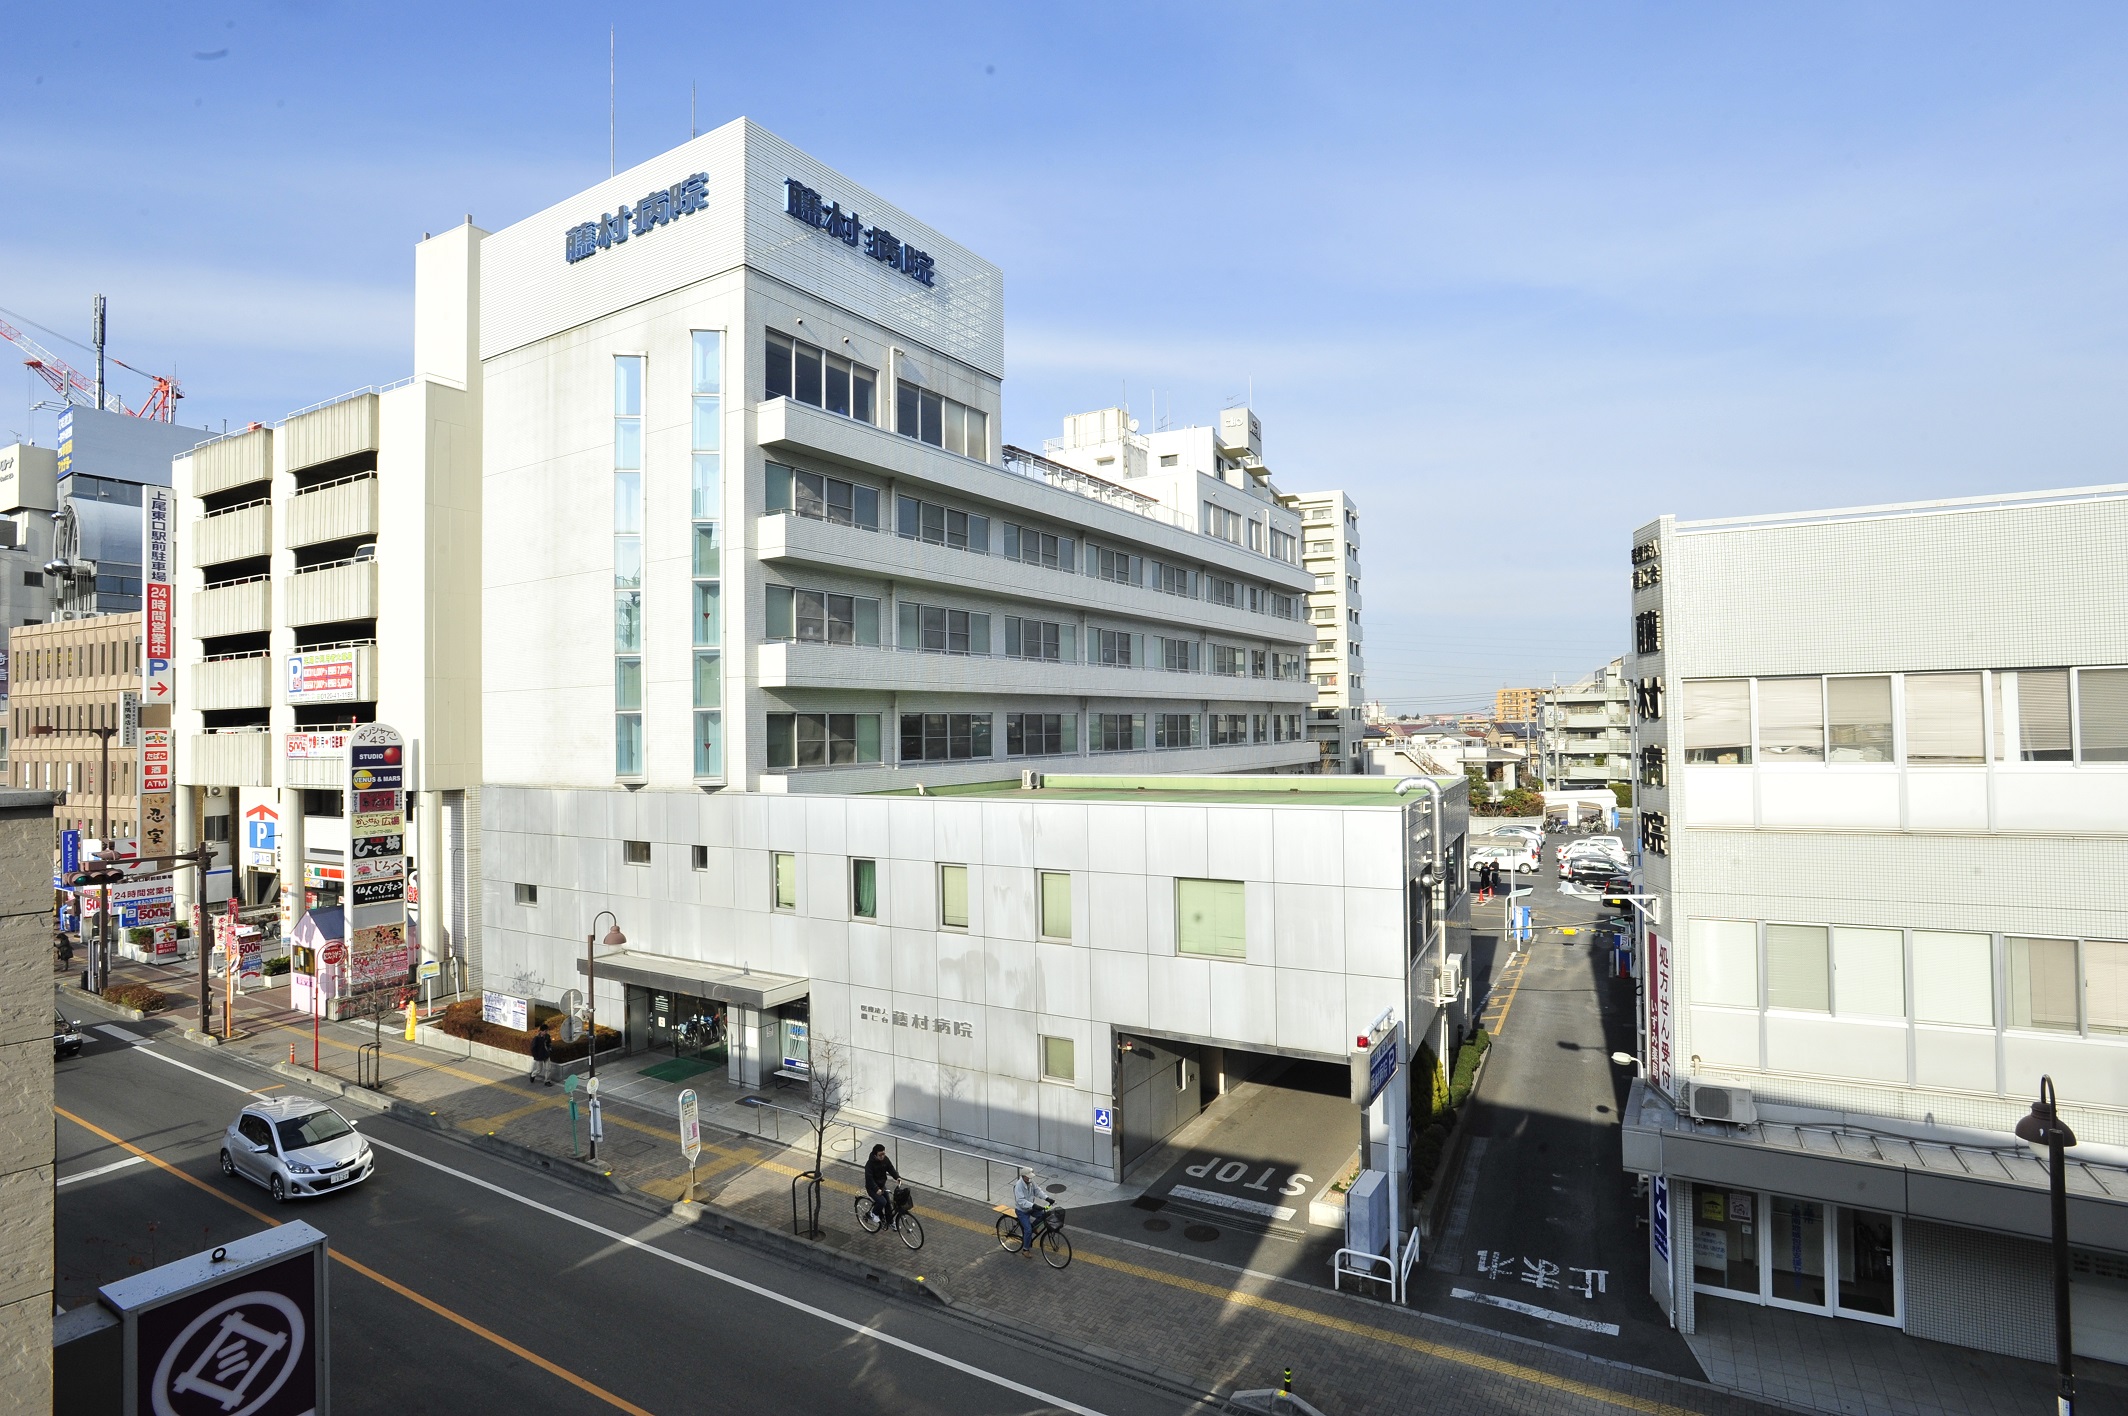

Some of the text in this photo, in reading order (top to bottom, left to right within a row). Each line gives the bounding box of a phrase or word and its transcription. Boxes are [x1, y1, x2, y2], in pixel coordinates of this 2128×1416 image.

[566, 172, 709, 265] 藤村病院
[783, 177, 935, 287] 藤村病院
[151, 491, 167, 582] 上尾東口駅前駐車場
[151, 587, 167, 656] 24時間営業中
[150, 658, 168, 677] P
[358, 727, 398, 741] サンシャイン
[369, 736, 386, 745] 43
[146, 752, 167, 760] たばこ
[146, 780, 166, 788] ATM
[256, 822, 268, 848] P
[354, 836, 400, 857] ひで坊
[114, 886, 173, 900] 24時間営業中
[1659, 944, 1671, 1091] 処方せん受付
[1184, 1157, 1314, 1196] STOP
[1477, 1250, 1609, 1299] 止まれ
